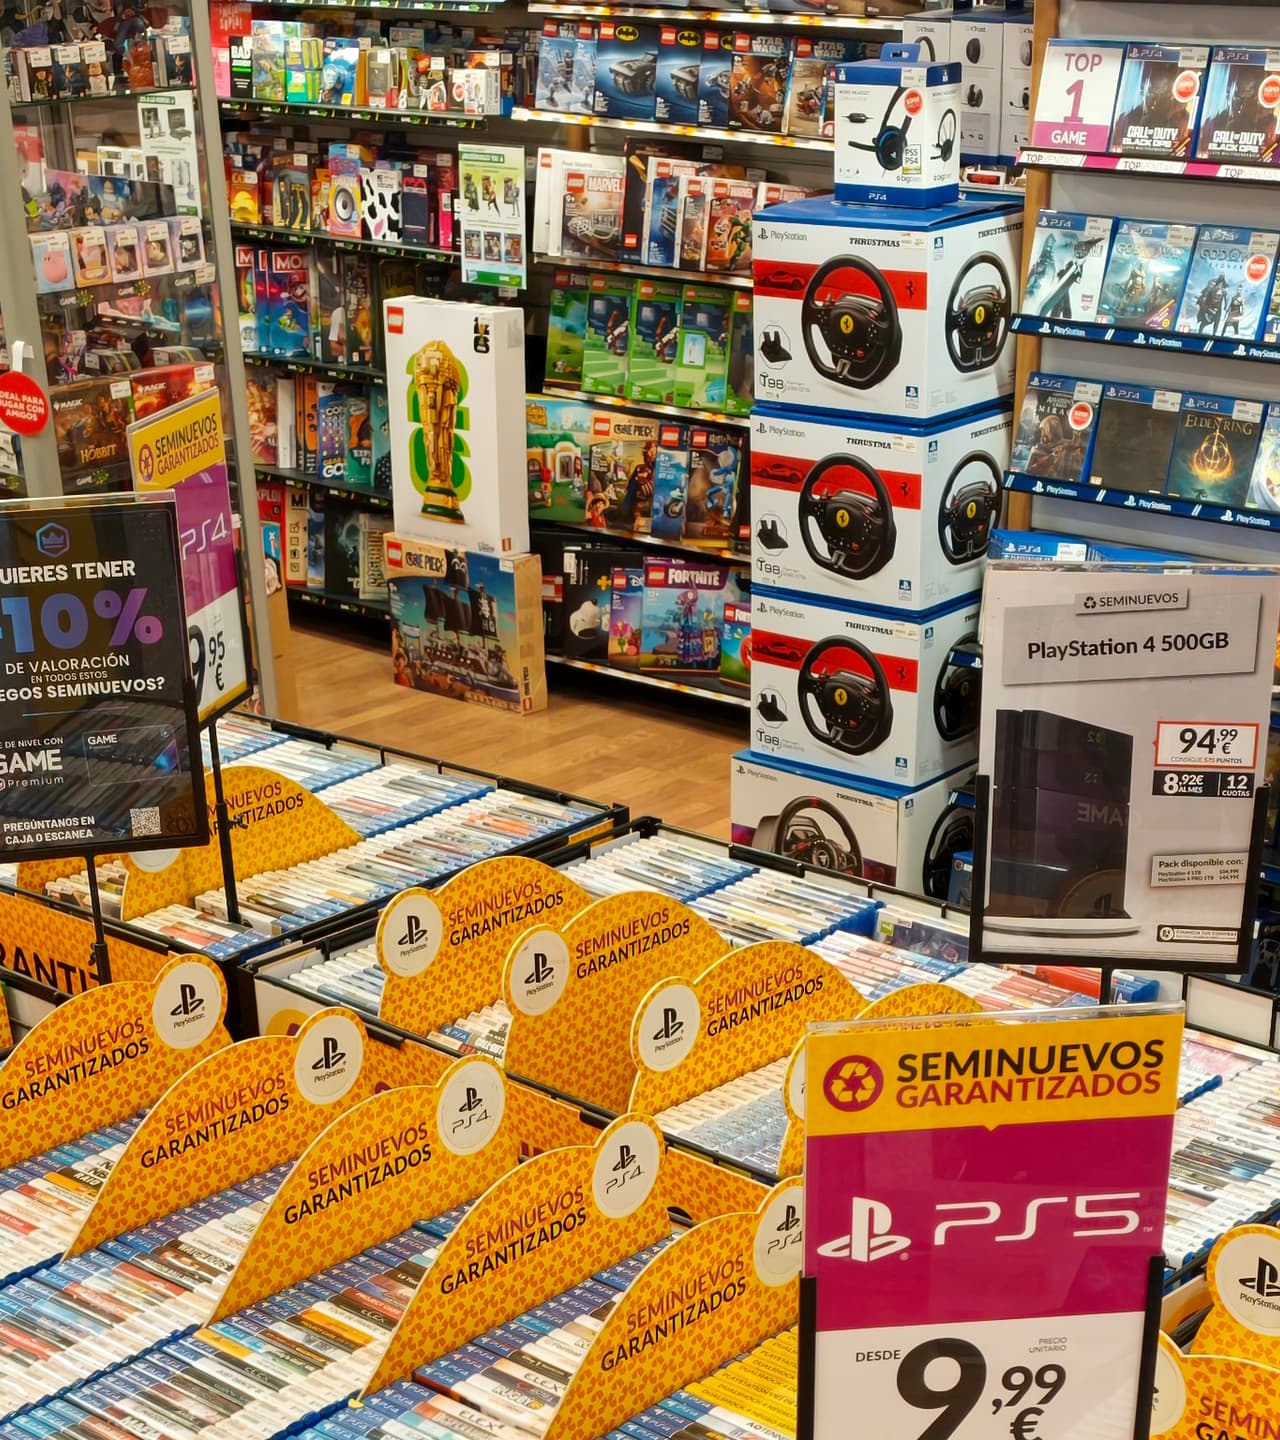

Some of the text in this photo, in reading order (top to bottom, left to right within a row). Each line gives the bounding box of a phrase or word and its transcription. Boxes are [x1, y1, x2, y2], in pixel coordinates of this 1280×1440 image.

[1064, 53, 1103, 72] TOP
[1064, 79, 1084, 123] 1
[1051, 130, 1087, 146] GAME
[1127, 126, 1147, 138] CALL
[1154, 128, 1178, 140] DUTY
[1153, 139, 1171, 148] OPS
[588, 175, 623, 193] MARVEL
[770, 231, 808, 241] PlayStation
[22, 395, 44, 405] PARA
[26, 404, 44, 413] CON
[5, 409, 38, 421] AMIGOS
[1184, 413, 1254, 436] ELDEN RING
[155, 413, 217, 458] SEMINUEVOS
[81, 444, 117, 463] HOBBIT
[157, 433, 219, 475] GARANTIZADOS
[181, 512, 229, 560] PS4
[72, 560, 136, 579] TENER
[668, 568, 720, 587] FORTNITE
[1099, 592, 1179, 608] SEMINUEVOS
[1027, 631, 1229, 661] PlayStation 4 500GB
[6, 652, 130, 675] DE VALORACIÓN
[31, 671, 108, 684] EN TODOS ESTOS
[47, 677, 165, 698] SEMINUEVOS?
[5, 741, 16, 749] DE
[18, 739, 41, 748] NIVEL
[44, 737, 64, 745] CON
[7, 776, 64, 788] Premium
[1227, 775, 1248, 789] 12
[3, 816, 95, 832] PREGÚNTANOS EN
[5, 830, 94, 845] CAJA O ESCANEA
[1159, 858, 1244, 869] Pack disponible con:
[447, 877, 543, 928] SEMINUEVOS
[449, 890, 565, 946] GARANTIZADOS
[706, 962, 804, 1017] SEMINUEVOS
[706, 974, 825, 1038] GARANTIZADOS
[24, 1016, 146, 1079] SEMINUEVOS
[896, 1039, 1164, 1083] SEMINUEVOS
[1, 1036, 150, 1112] GARANTIZADOS
[896, 1069, 1162, 1110] GARANTIZADOS
[308, 1121, 430, 1191] SEMINUEVOS
[283, 1143, 433, 1226] GARANTIZADOS
[605, 1163, 645, 1196] PS4
[464, 1184, 584, 1261] SEMINUEVOS
[933, 1192, 1141, 1246] PS5
[439, 1206, 588, 1296] GARANTIZADOS
[625, 1254, 745, 1335] SEMINUEVOS
[600, 1274, 747, 1373] GARANTIZADOS
[1028, 1344, 1068, 1352] UNITARIO
[1038, 1336, 1068, 1345] PRECIO
[855, 1348, 901, 1362] DESDE
